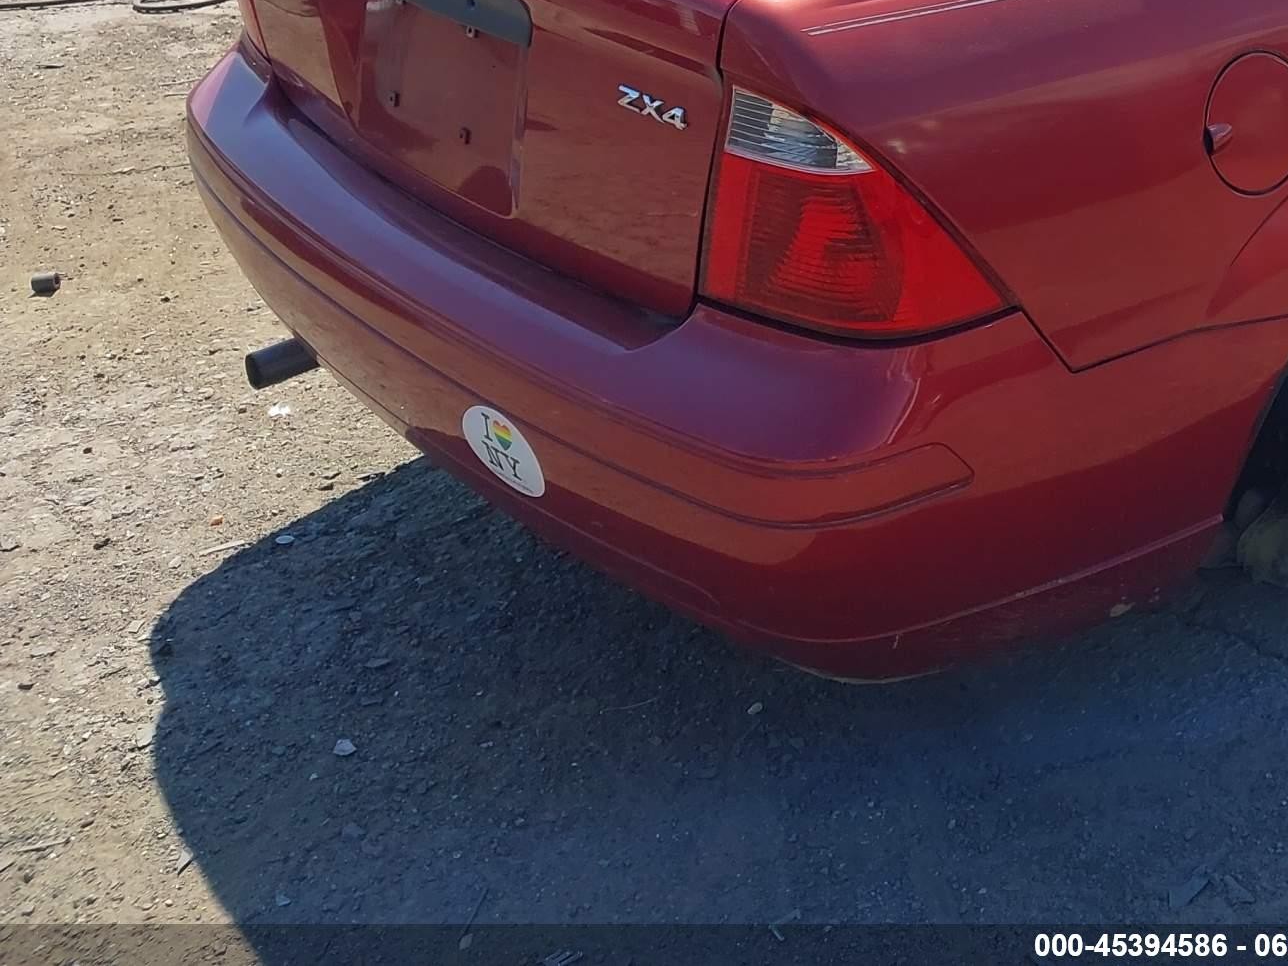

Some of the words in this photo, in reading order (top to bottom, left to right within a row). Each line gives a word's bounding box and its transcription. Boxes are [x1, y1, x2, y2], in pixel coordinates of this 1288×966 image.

[617, 84, 688, 131] ZX4
[481, 412, 493, 442] I
[481, 439, 523, 481] NY
